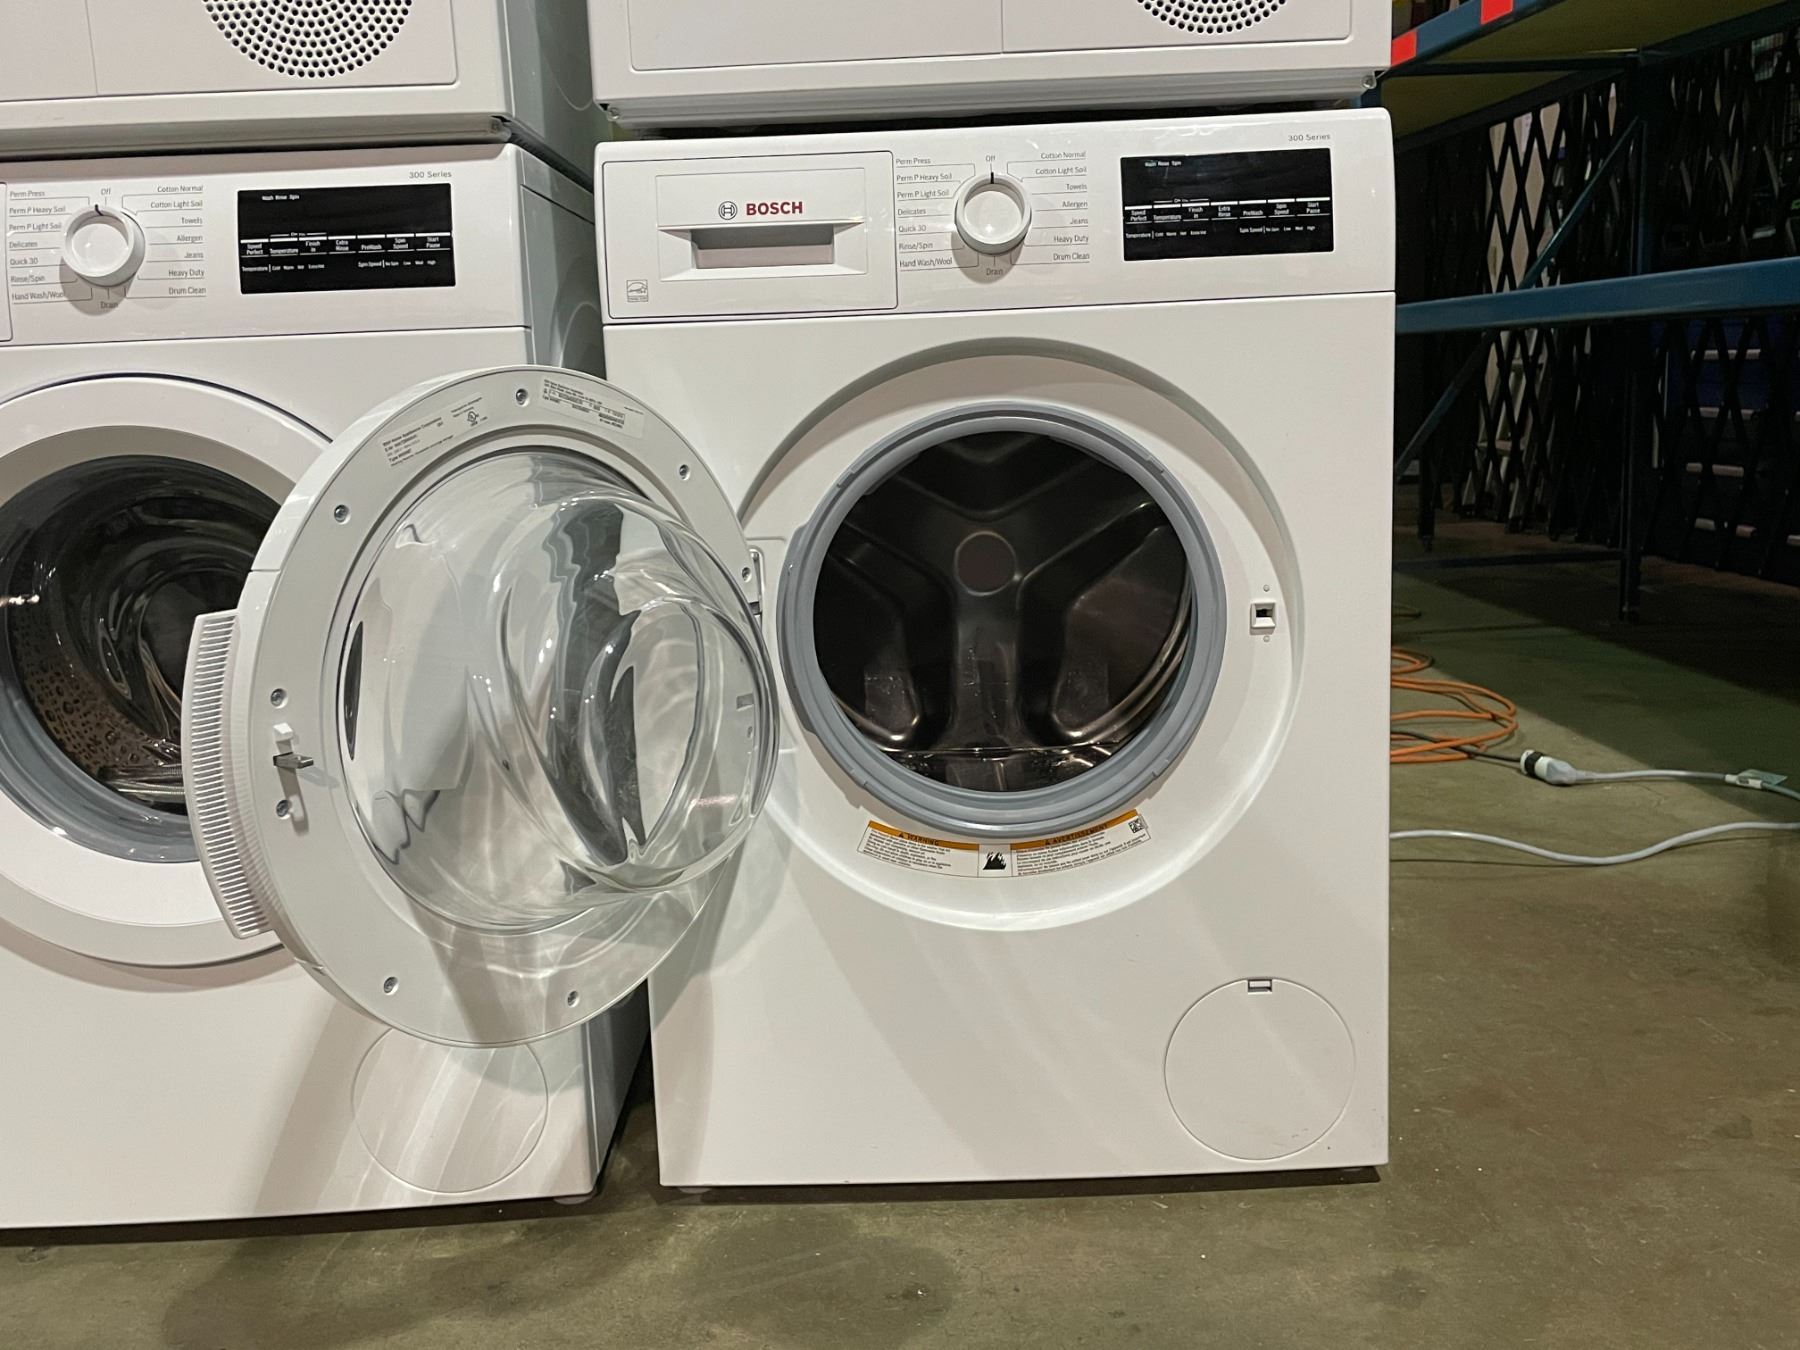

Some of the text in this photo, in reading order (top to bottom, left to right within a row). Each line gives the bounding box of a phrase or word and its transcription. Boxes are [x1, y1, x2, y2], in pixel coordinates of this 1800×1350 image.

[1306, 133, 1330, 141] Series
[409, 170, 452, 179] 300 Series
[1058, 167, 1073, 175] Light
[920, 190, 936, 198] Light
[173, 200, 189, 208] Light
[1062, 201, 1088, 209] Allergen
[33, 206, 50, 214] Heavy
[746, 201, 803, 216] BOSCH
[32, 223, 48, 231] Light
[176, 235, 203, 243] Allergen
[1054, 235, 1088, 244] Heavy Duty
[899, 242, 933, 250] Rinse/Spin
[917, 257, 952, 267] Wash/Wool
[169, 269, 205, 278] Heavy Duty
[10, 274, 45, 283] Rinse/Spin
[100, 301, 118, 309] Drain
[1050, 823, 1108, 845] AVERTISSEMENT
[908, 832, 939, 846] WARNING
